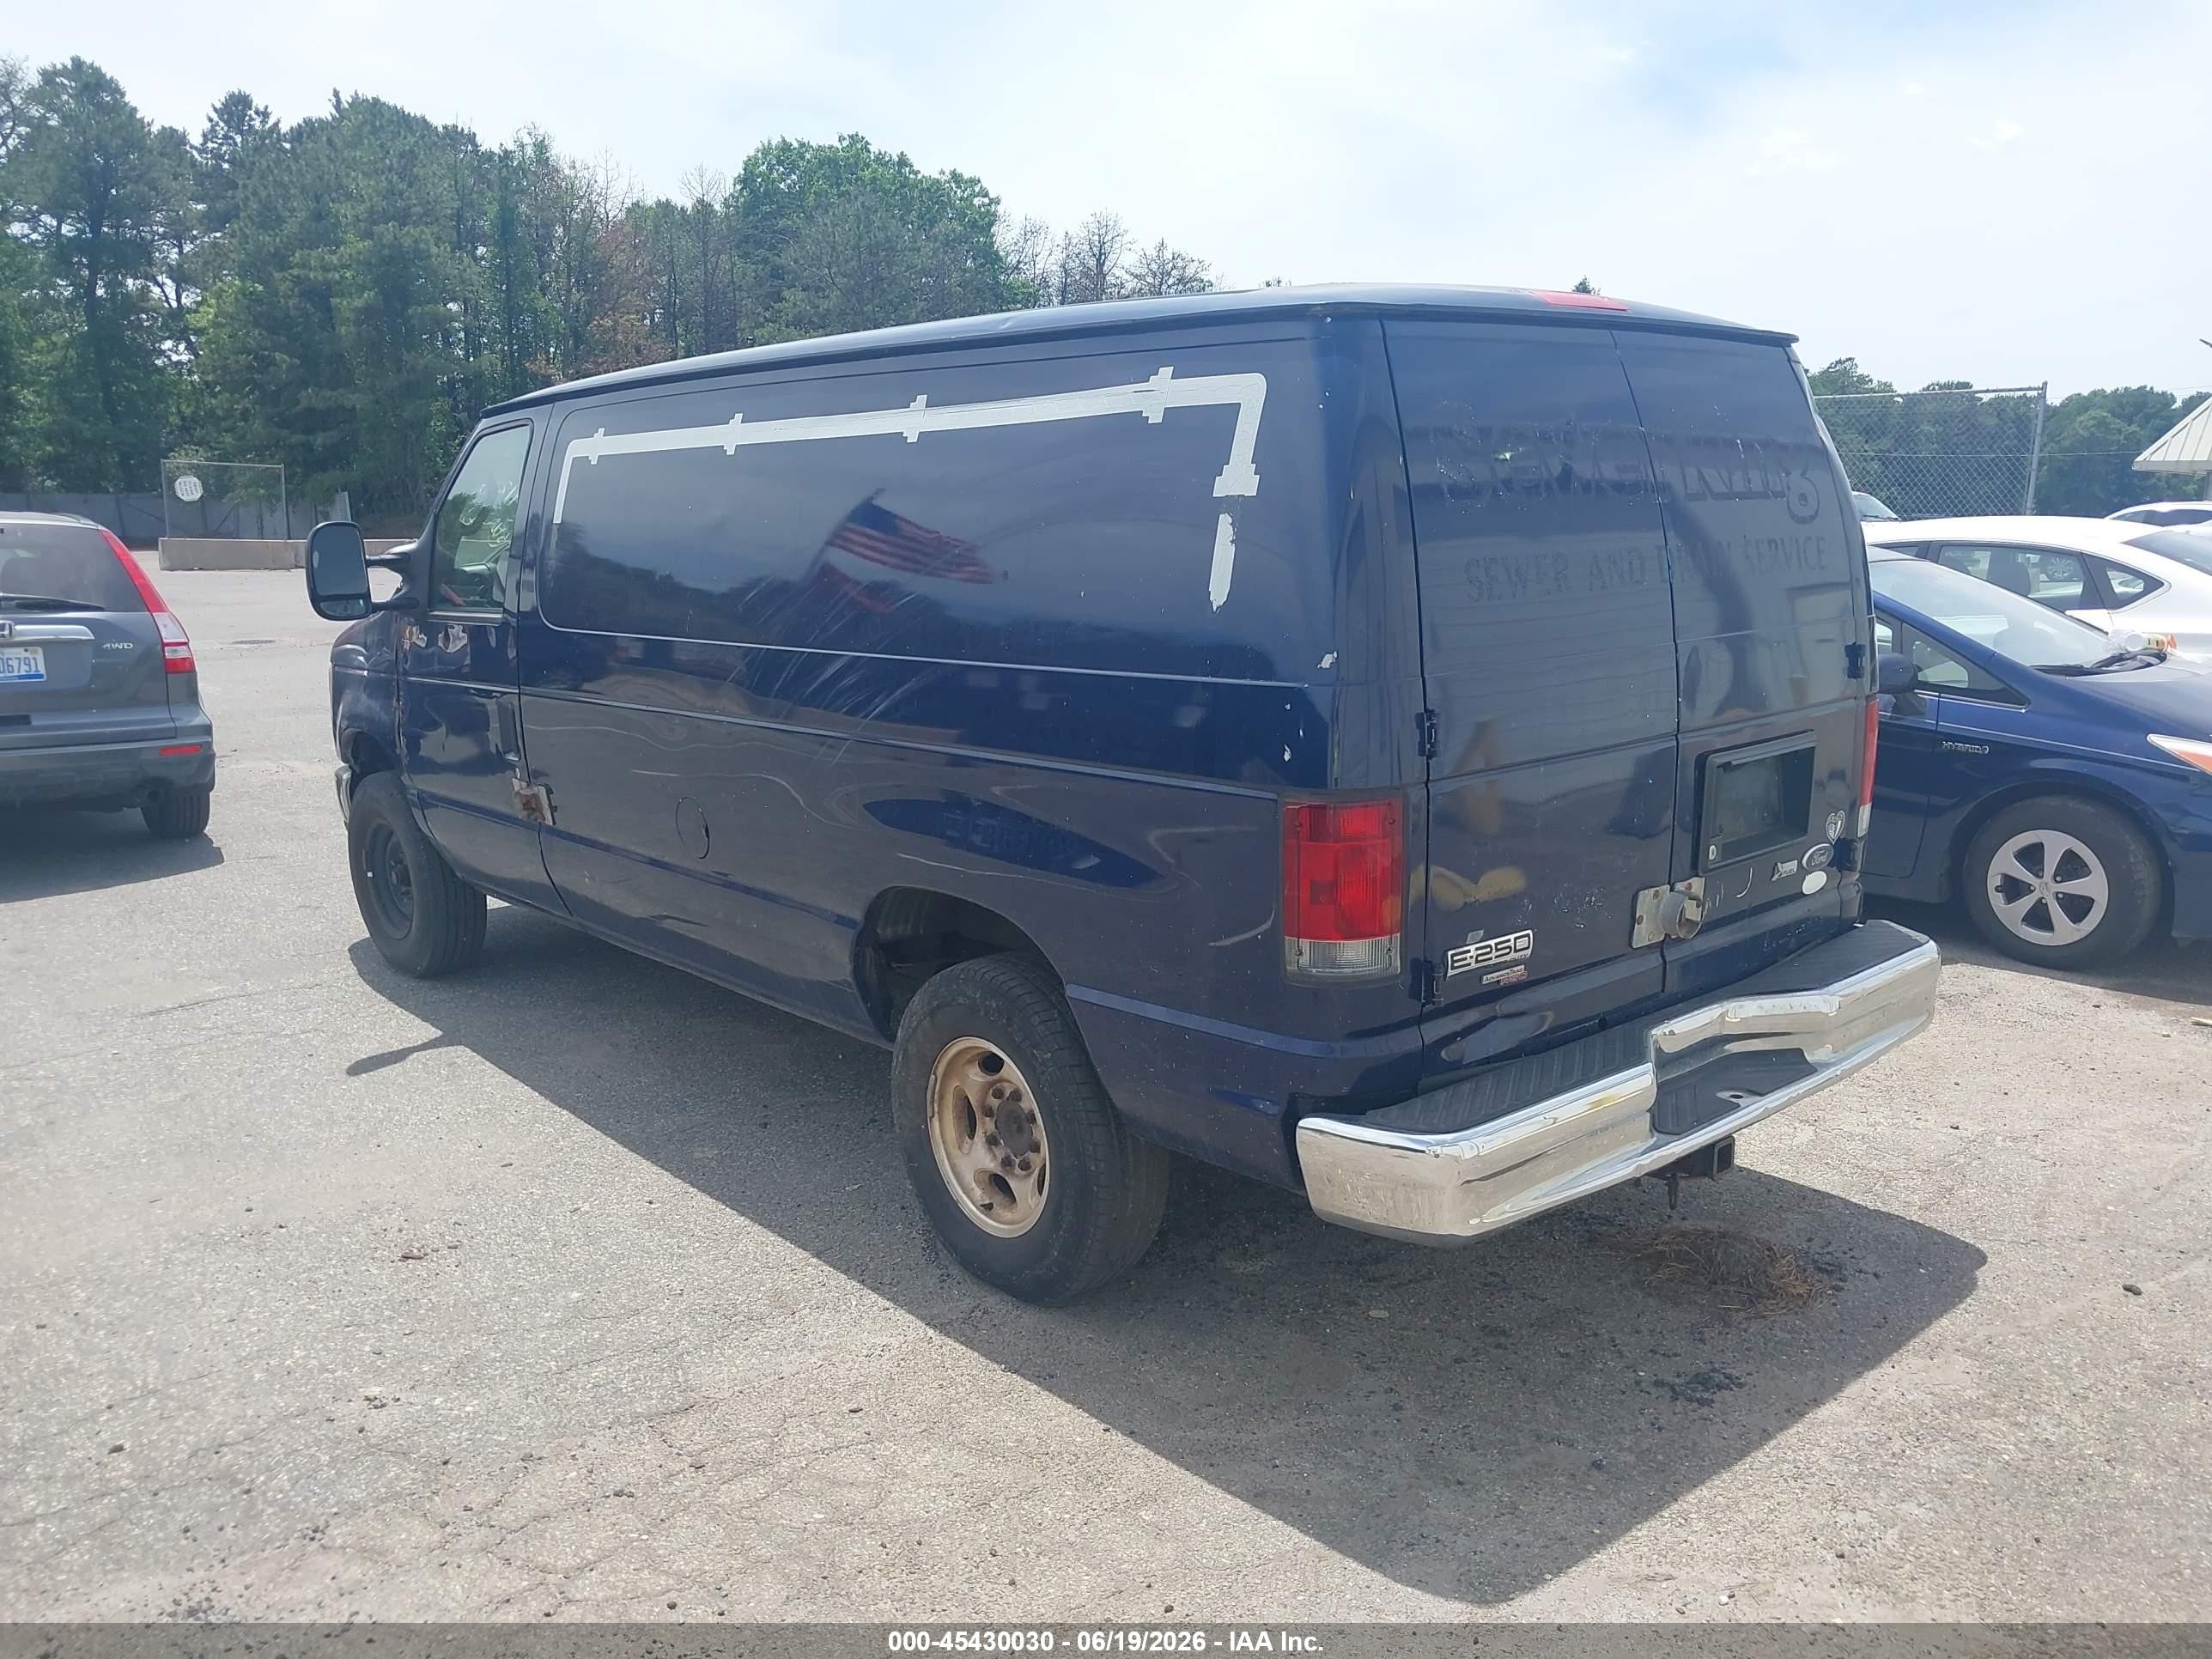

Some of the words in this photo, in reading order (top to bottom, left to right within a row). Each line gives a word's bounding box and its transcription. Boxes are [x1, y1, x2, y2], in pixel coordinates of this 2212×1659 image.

[1942, 741, 1983, 754] HYBRID
[1811, 850, 1828, 866] Ford
[1449, 933, 1531, 971] E-250
